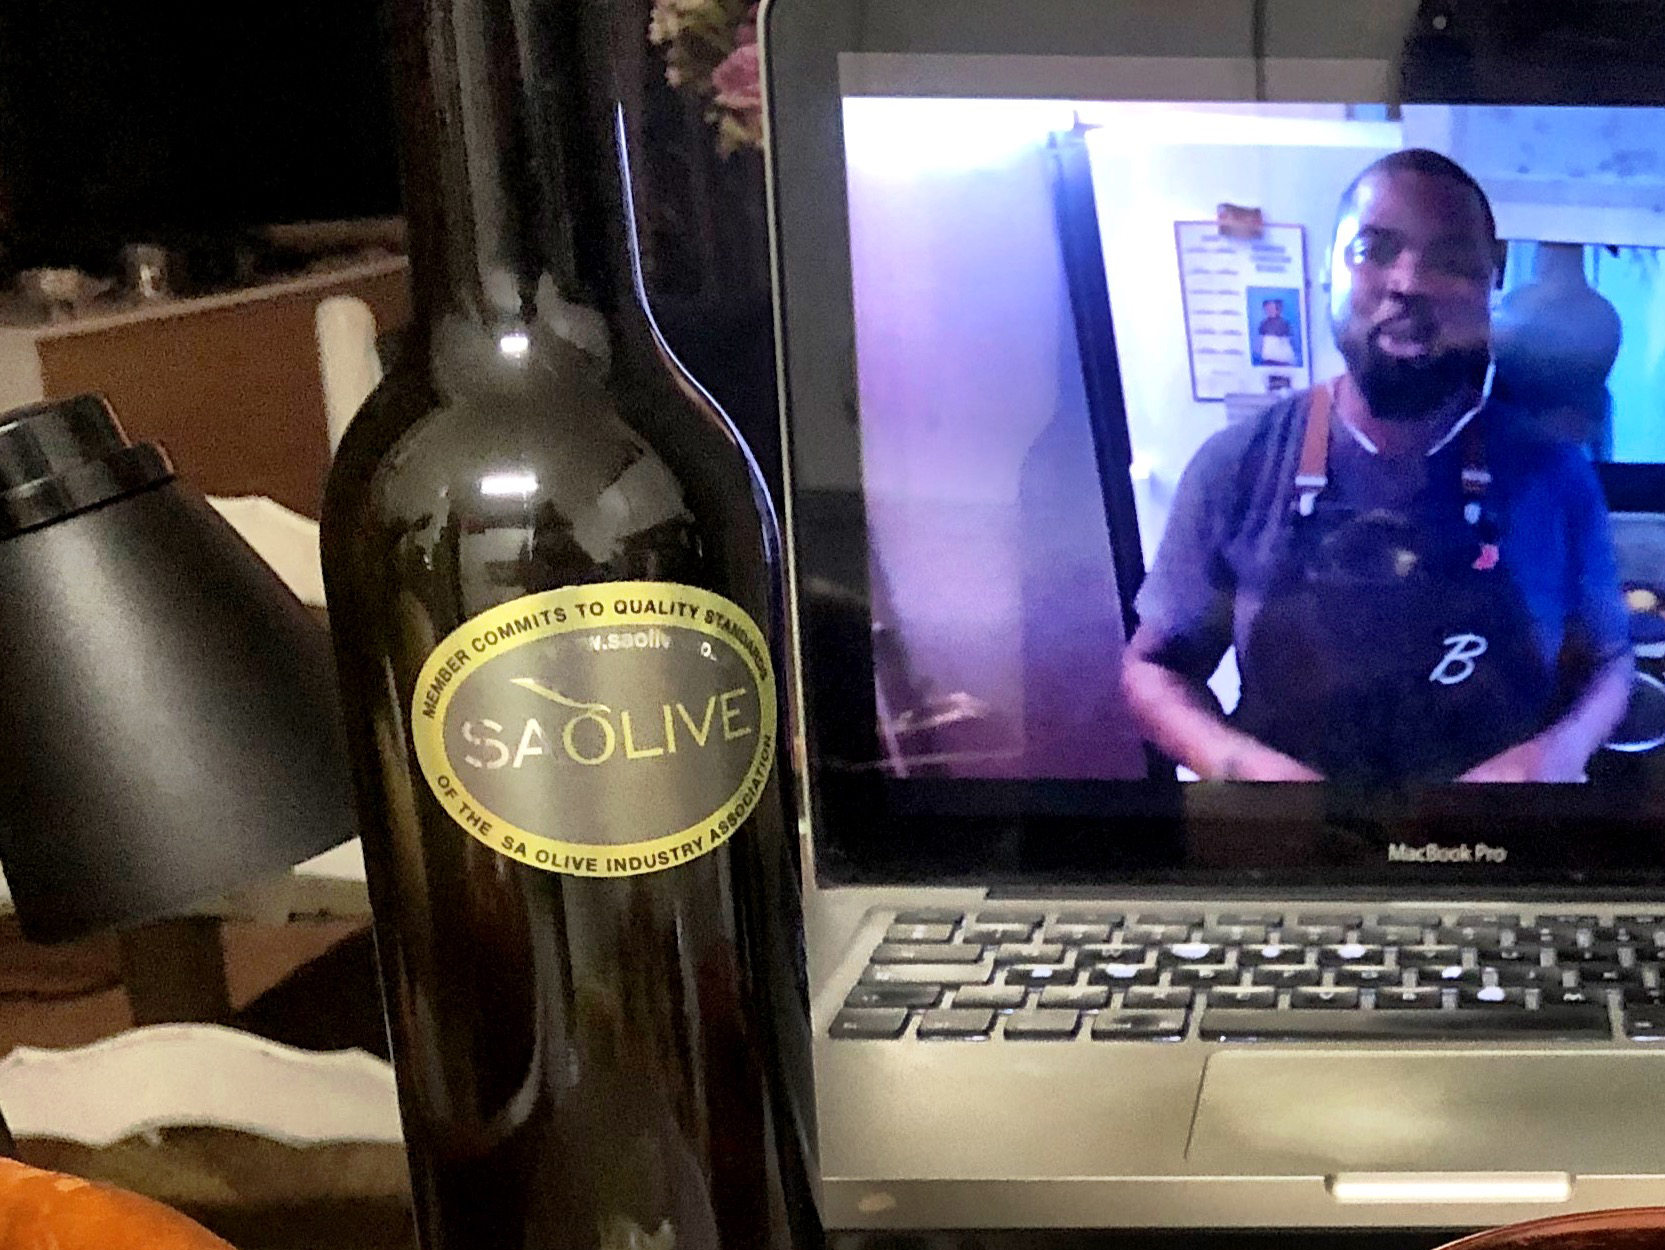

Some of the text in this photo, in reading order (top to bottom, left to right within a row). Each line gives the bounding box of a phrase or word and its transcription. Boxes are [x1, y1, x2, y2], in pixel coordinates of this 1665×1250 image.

[422, 649, 472, 720] MEMBER
[471, 607, 567, 653] COMMITS
[575, 602, 604, 619] TO
[614, 600, 700, 619] QUALITY
[1429, 633, 1488, 685] B
[437, 733, 772, 872] OF THE SA OLIVE INDUSTRY ASSOCIATION
[1388, 842, 1508, 864] MacBook Pro
